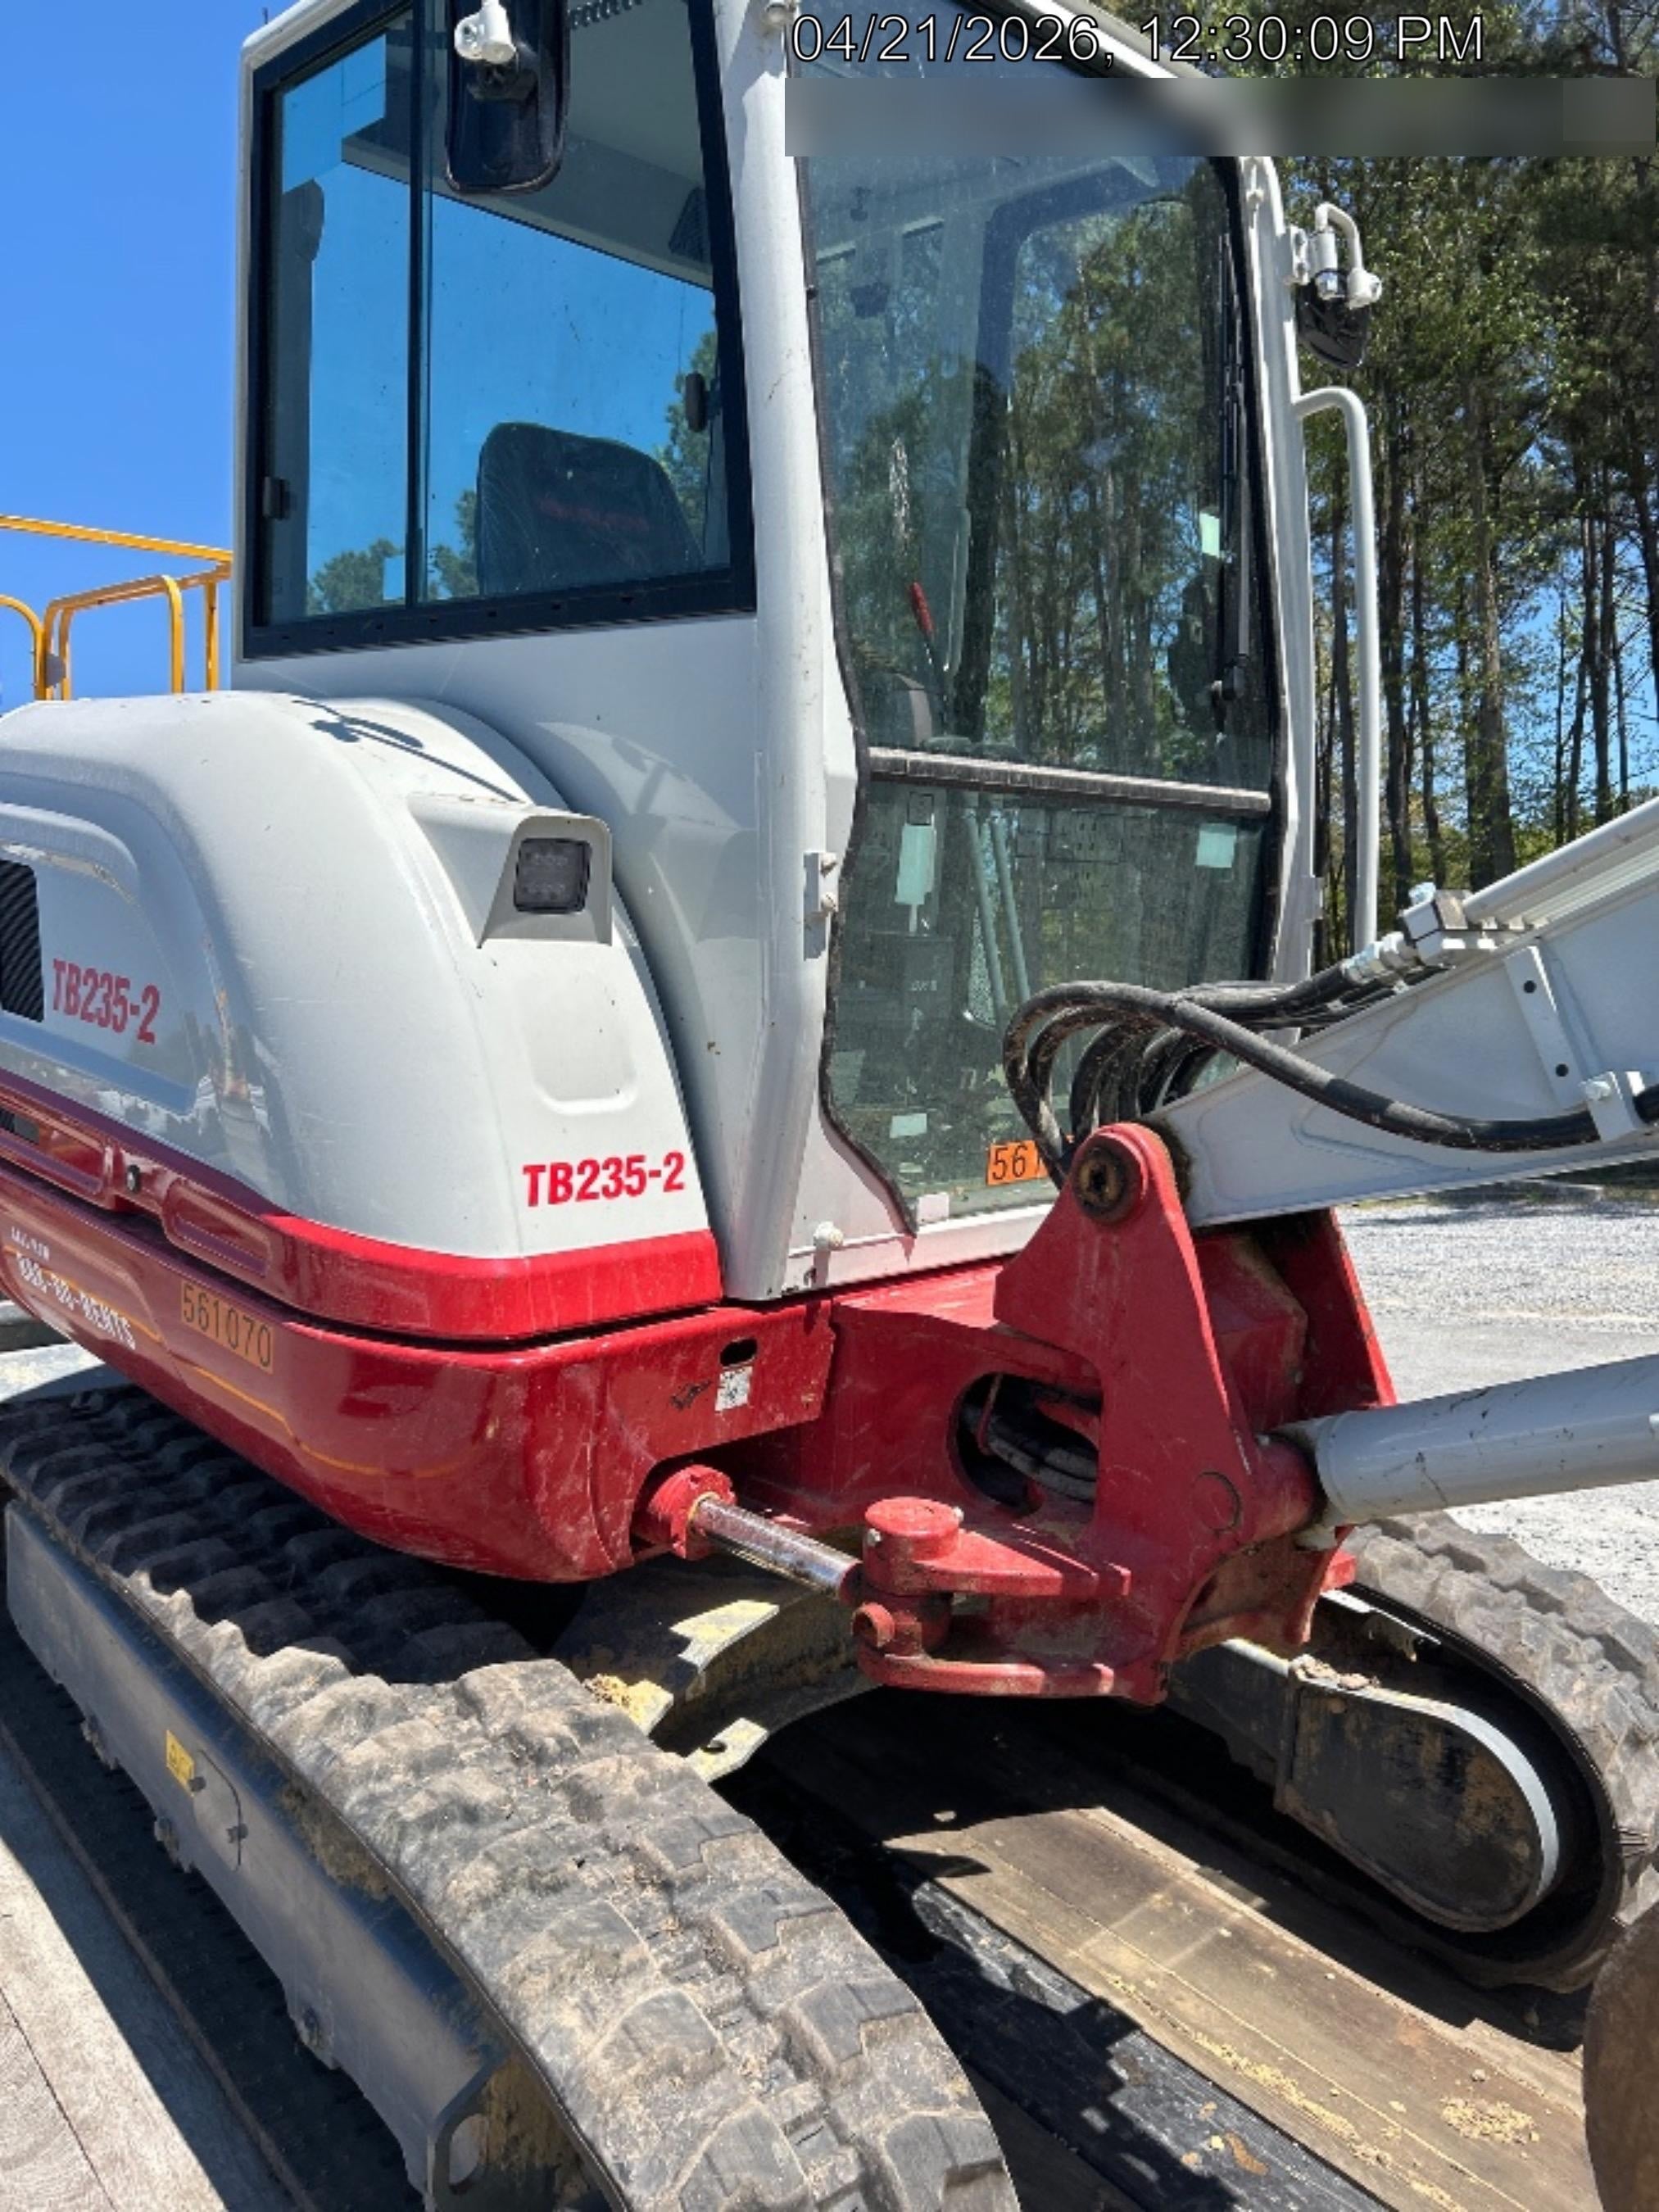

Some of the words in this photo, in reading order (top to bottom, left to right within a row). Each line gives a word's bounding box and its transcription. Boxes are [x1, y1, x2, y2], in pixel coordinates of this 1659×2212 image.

[52, 958, 160, 1045] TB235-2
[523, 1149, 685, 1207] TB235-2
[183, 1285, 272, 1368] 561070
